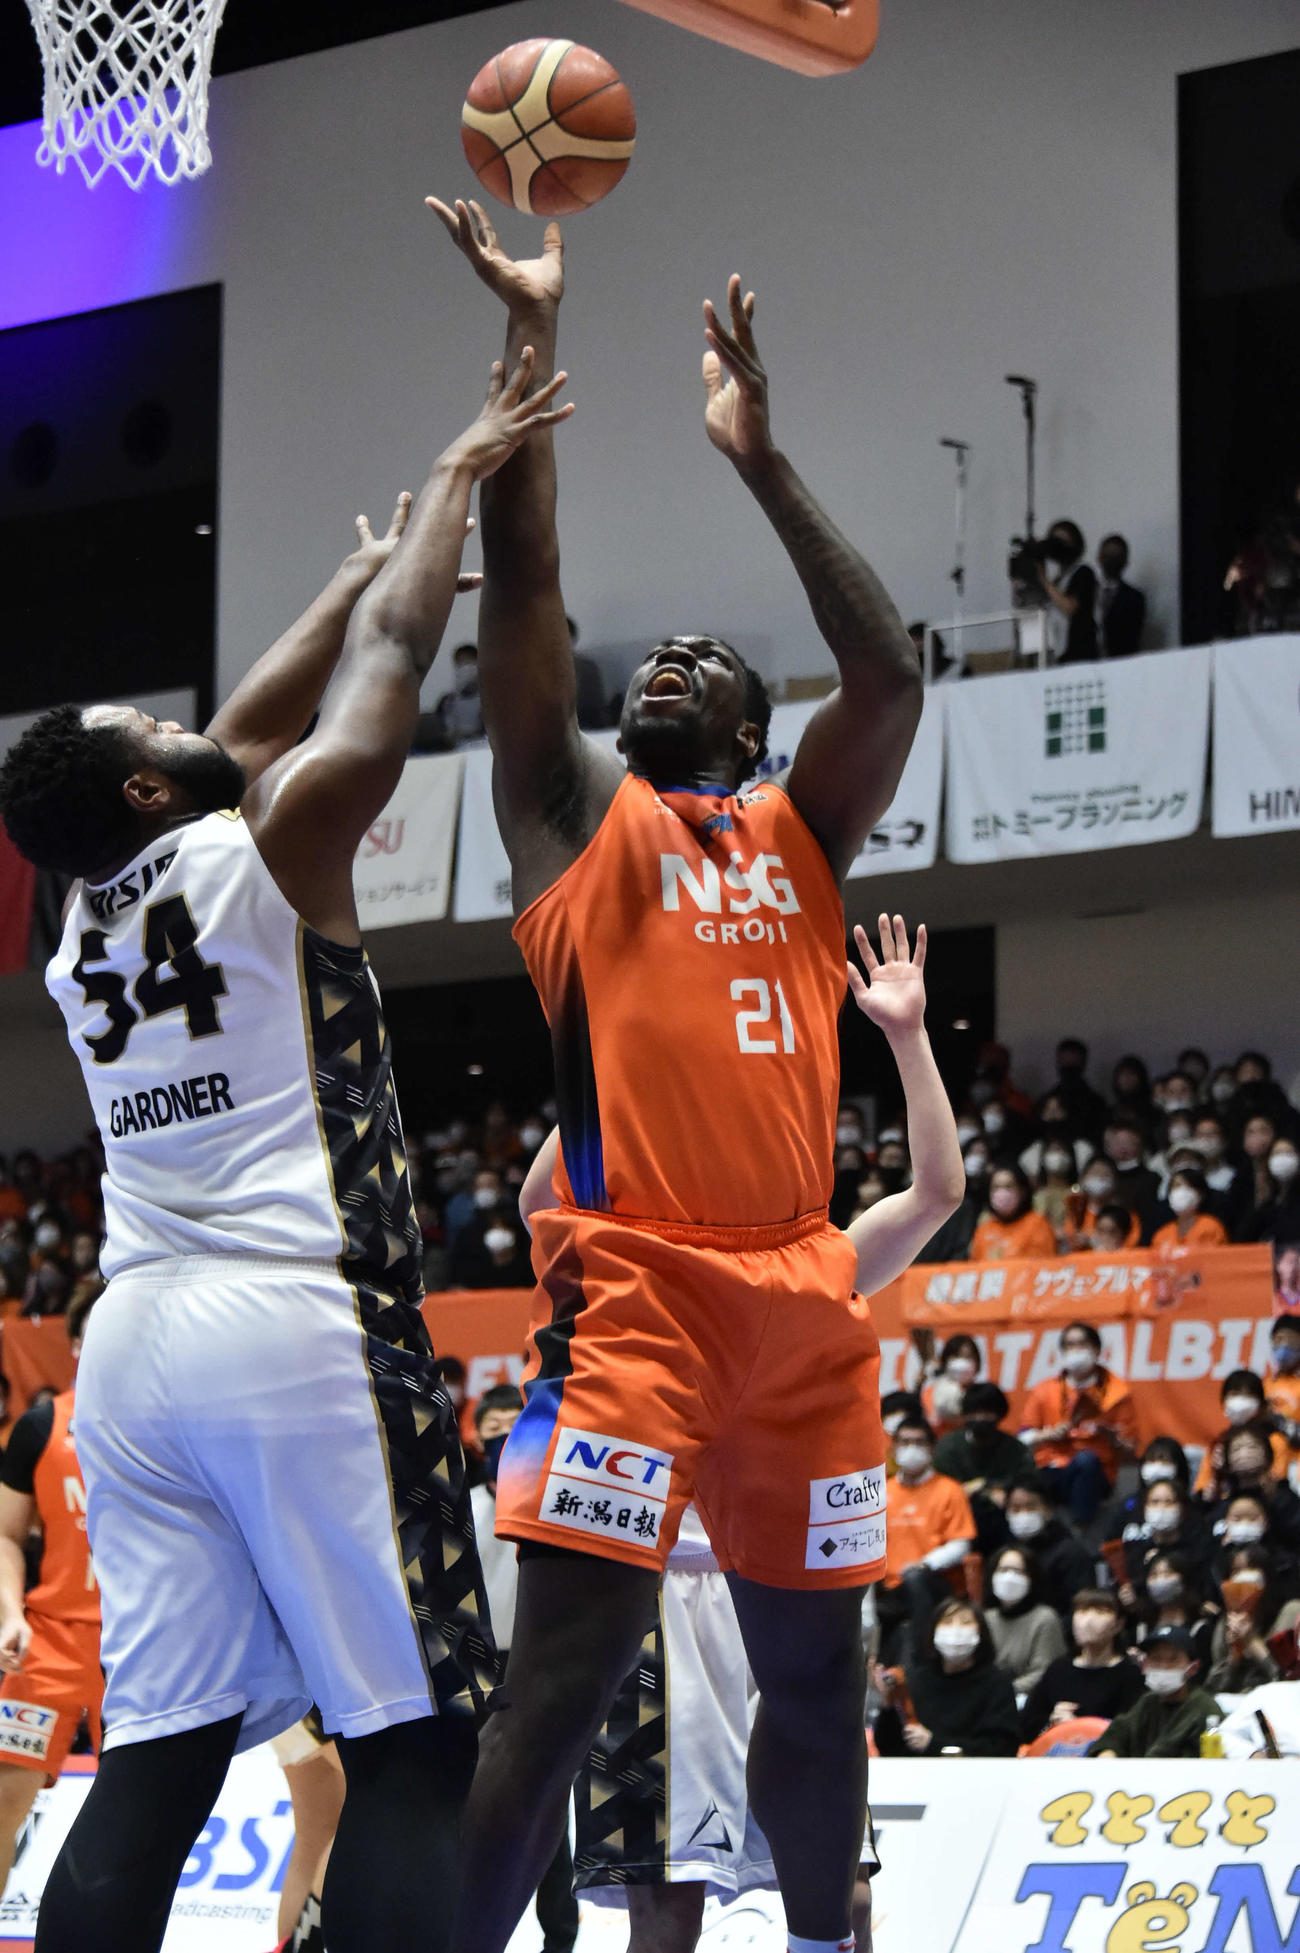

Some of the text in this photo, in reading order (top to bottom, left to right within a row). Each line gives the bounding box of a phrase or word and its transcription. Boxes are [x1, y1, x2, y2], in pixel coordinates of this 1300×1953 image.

[659, 850, 801, 915] NSG
[730, 977, 796, 1054] 21
[110, 1072, 235, 1138] GARDNER
[565, 1440, 665, 1484] NCT
[549, 1488, 657, 1538] 新潟日報
[826, 1476, 881, 1508] Crafty
[0, 1704, 53, 1727] NCT
[1013, 1861, 1300, 1953] TeN
